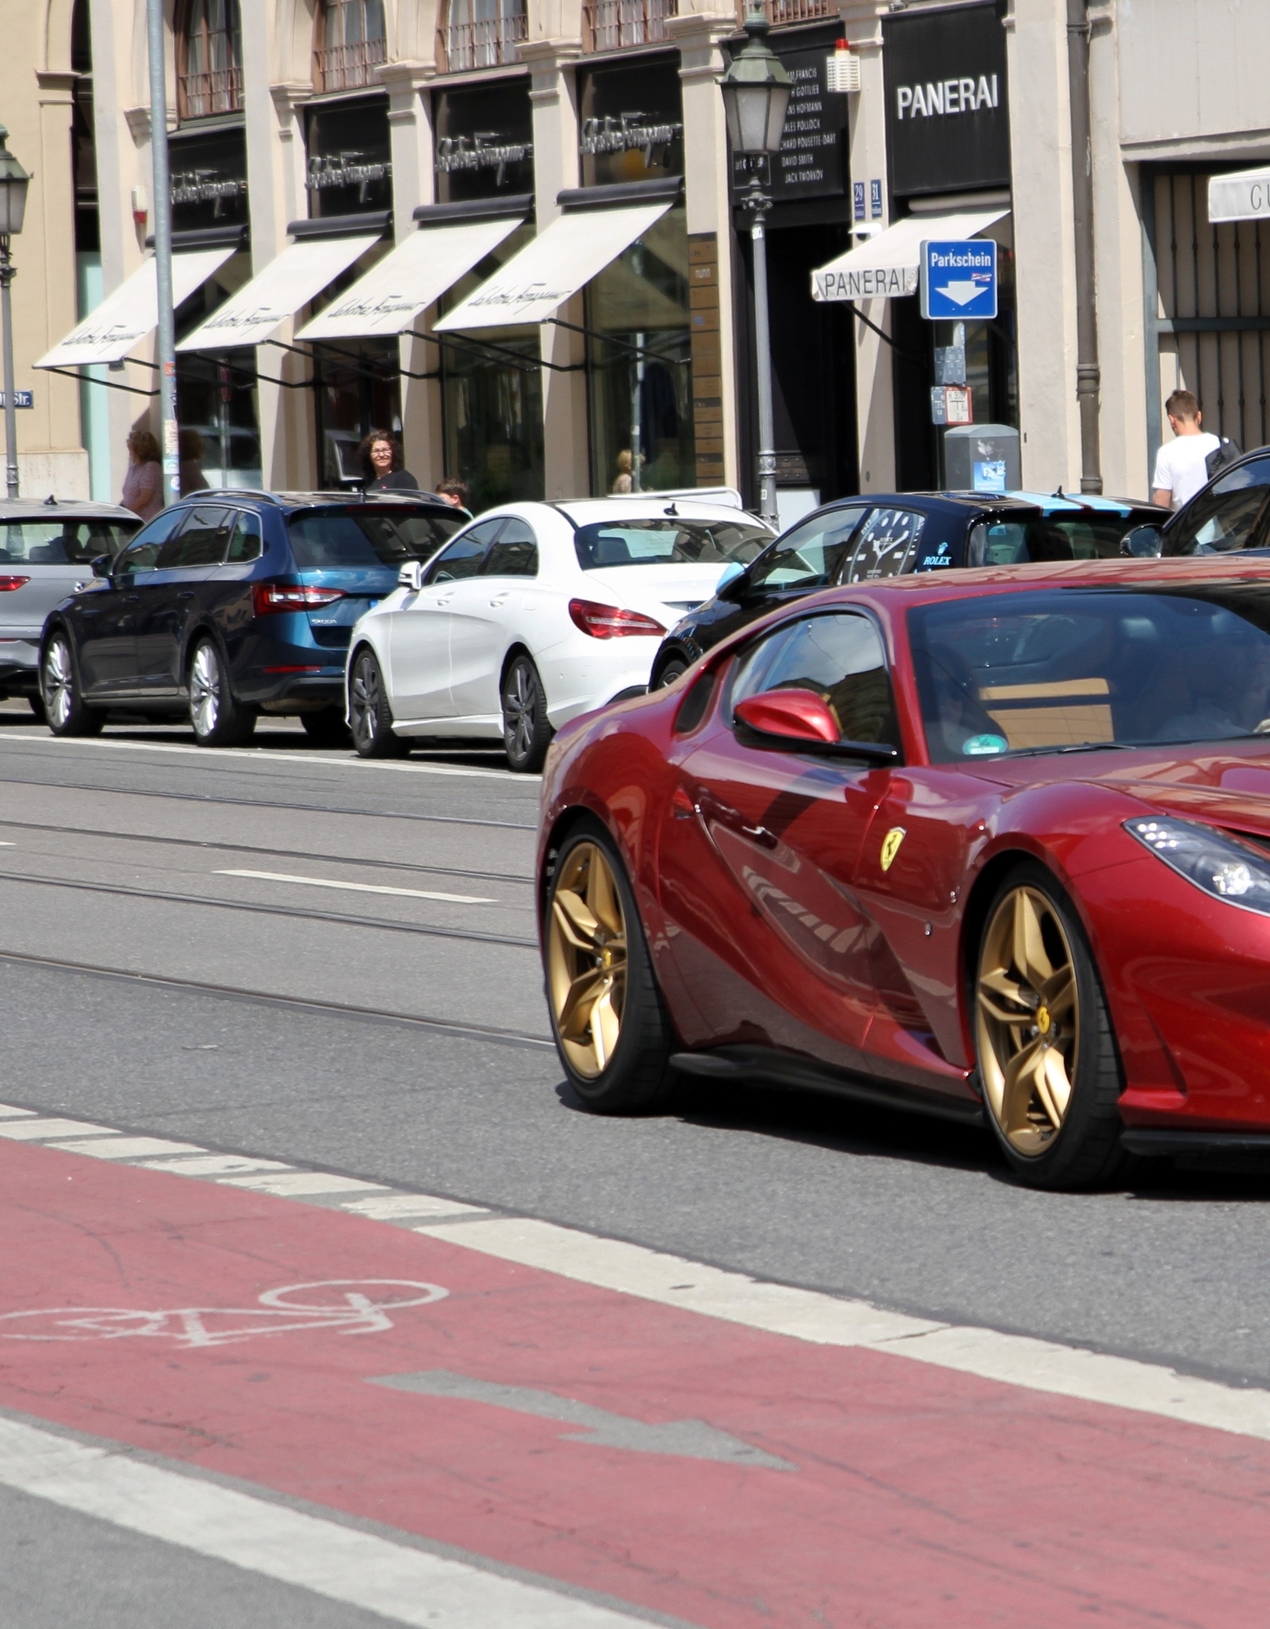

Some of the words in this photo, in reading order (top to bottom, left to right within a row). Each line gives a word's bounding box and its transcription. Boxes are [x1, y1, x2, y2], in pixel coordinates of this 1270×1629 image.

[897, 74, 999, 120] PANERAI
[796, 102, 823, 114] HOFMANN
[797, 118, 821, 131] POLLOCK
[782, 155, 797, 167] DAVID
[798, 153, 814, 165] SMITH
[785, 171, 798, 184] JACK
[799, 169, 824, 181] TWORKOV
[855, 184, 864, 201] 29
[872, 183, 879, 200] 31
[931, 252, 992, 268] Parkschein
[825, 268, 906, 297] PANERAI
[923, 556, 952, 566] ROLEX
